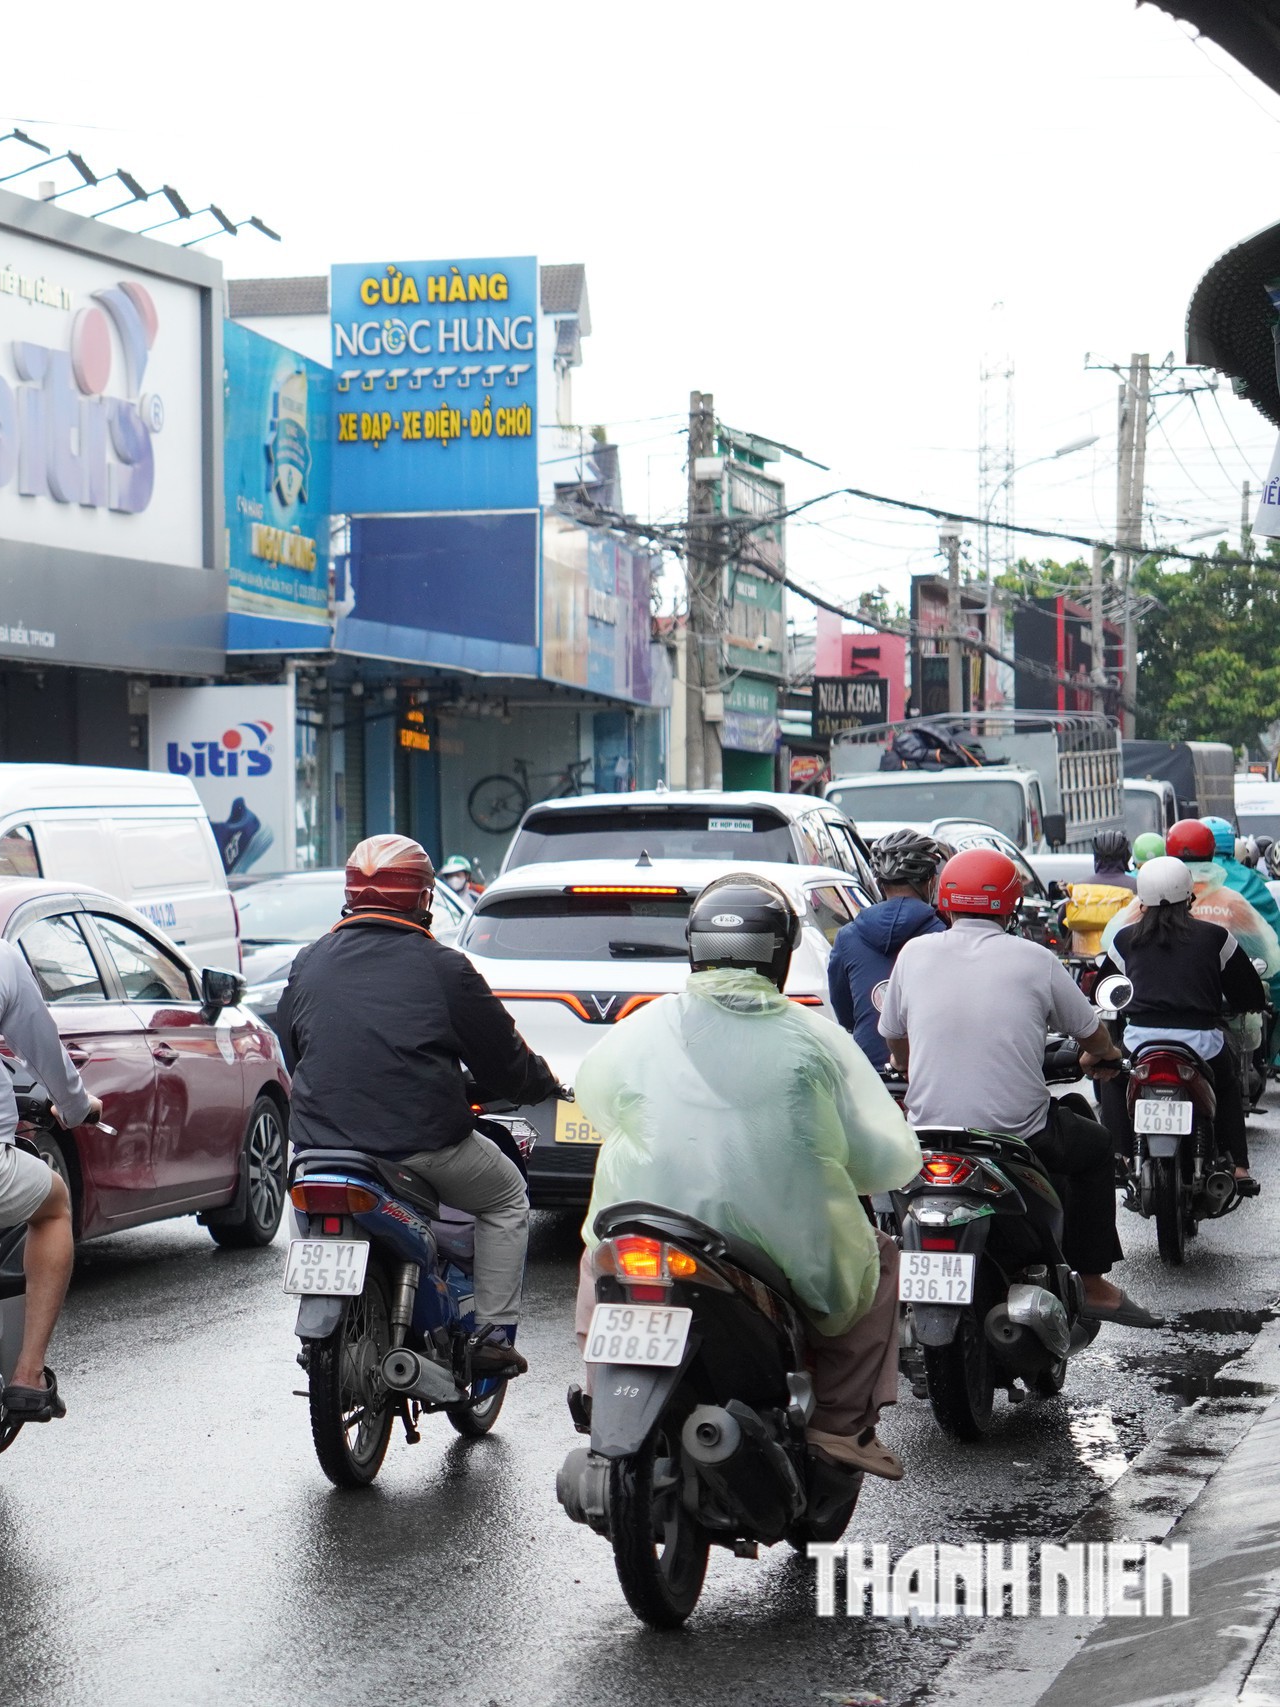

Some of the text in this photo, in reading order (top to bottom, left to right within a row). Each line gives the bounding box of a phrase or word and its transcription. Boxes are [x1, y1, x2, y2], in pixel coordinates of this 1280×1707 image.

[361, 265, 508, 305] CỬA HÀNG
[339, 413, 358, 442] XE
[361, 412, 391, 449] ĐẠP
[402, 411, 421, 440] XE
[424, 402, 460, 447] ĐIỆN
[471, 394, 492, 438] ĐỒ
[818, 682, 882, 713] NHA KHOA
[1144, 1103, 1184, 1118] 62-N1
[1143, 1118, 1183, 1132] 4091
[301, 1244, 355, 1268] 59-Y1
[909, 1255, 963, 1279] 59-NA
[289, 1267, 357, 1292] 455.54
[902, 1279, 968, 1302] 336.12
[606, 1309, 673, 1335] 59-E1
[591, 1335, 680, 1361] 088.67
